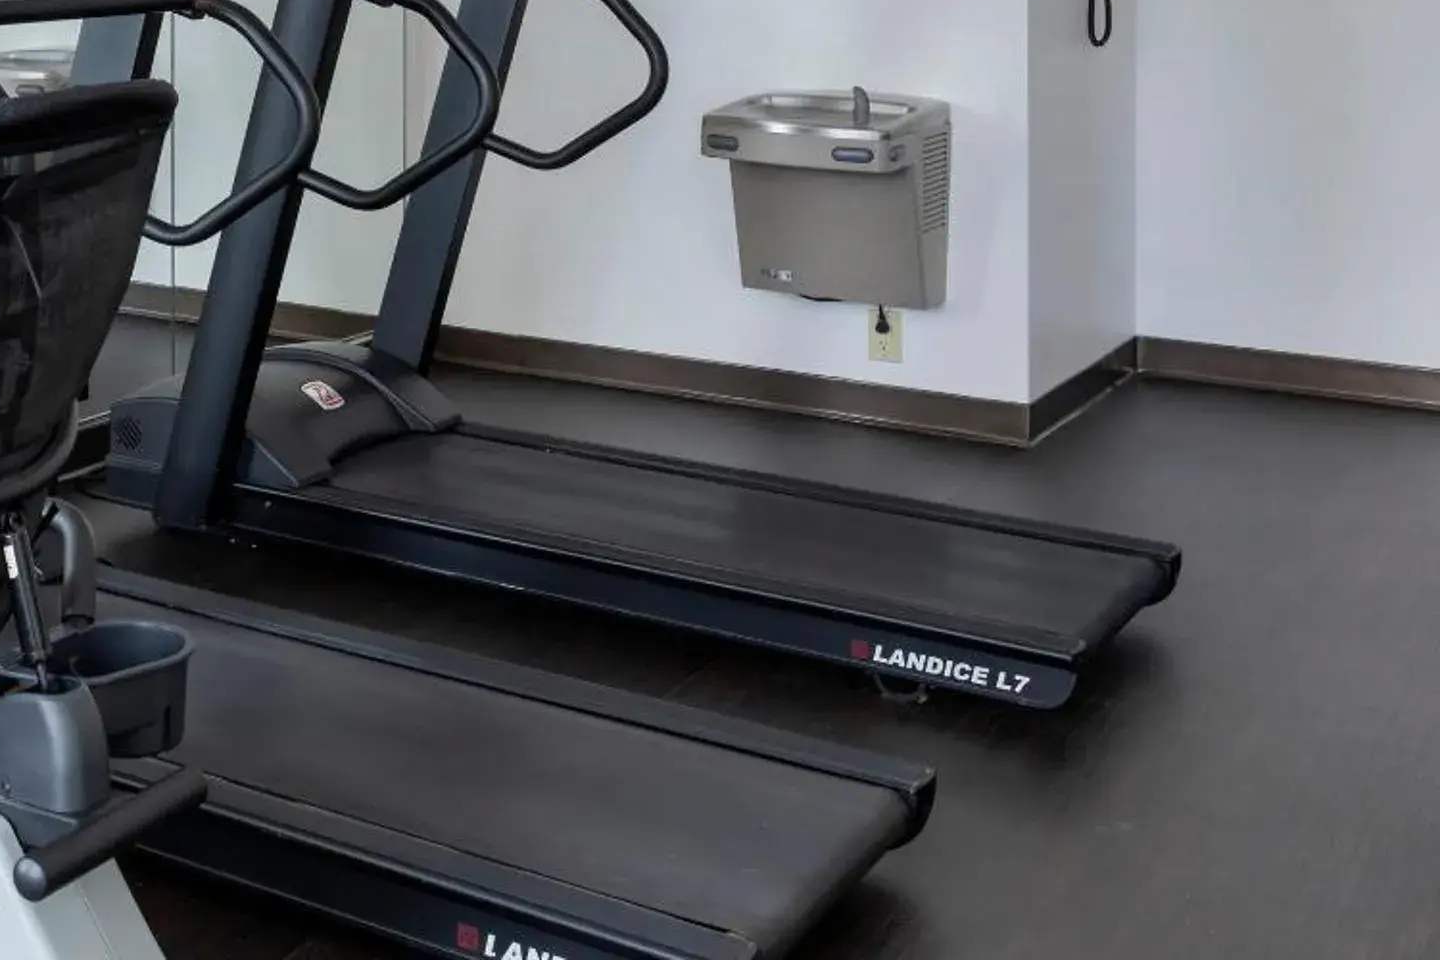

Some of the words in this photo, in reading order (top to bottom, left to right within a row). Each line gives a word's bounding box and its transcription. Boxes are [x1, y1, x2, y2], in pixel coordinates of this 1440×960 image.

[873, 644, 990, 685] LANDICE
[996, 671, 1031, 693] L7
[484, 934, 567, 960] LAN
